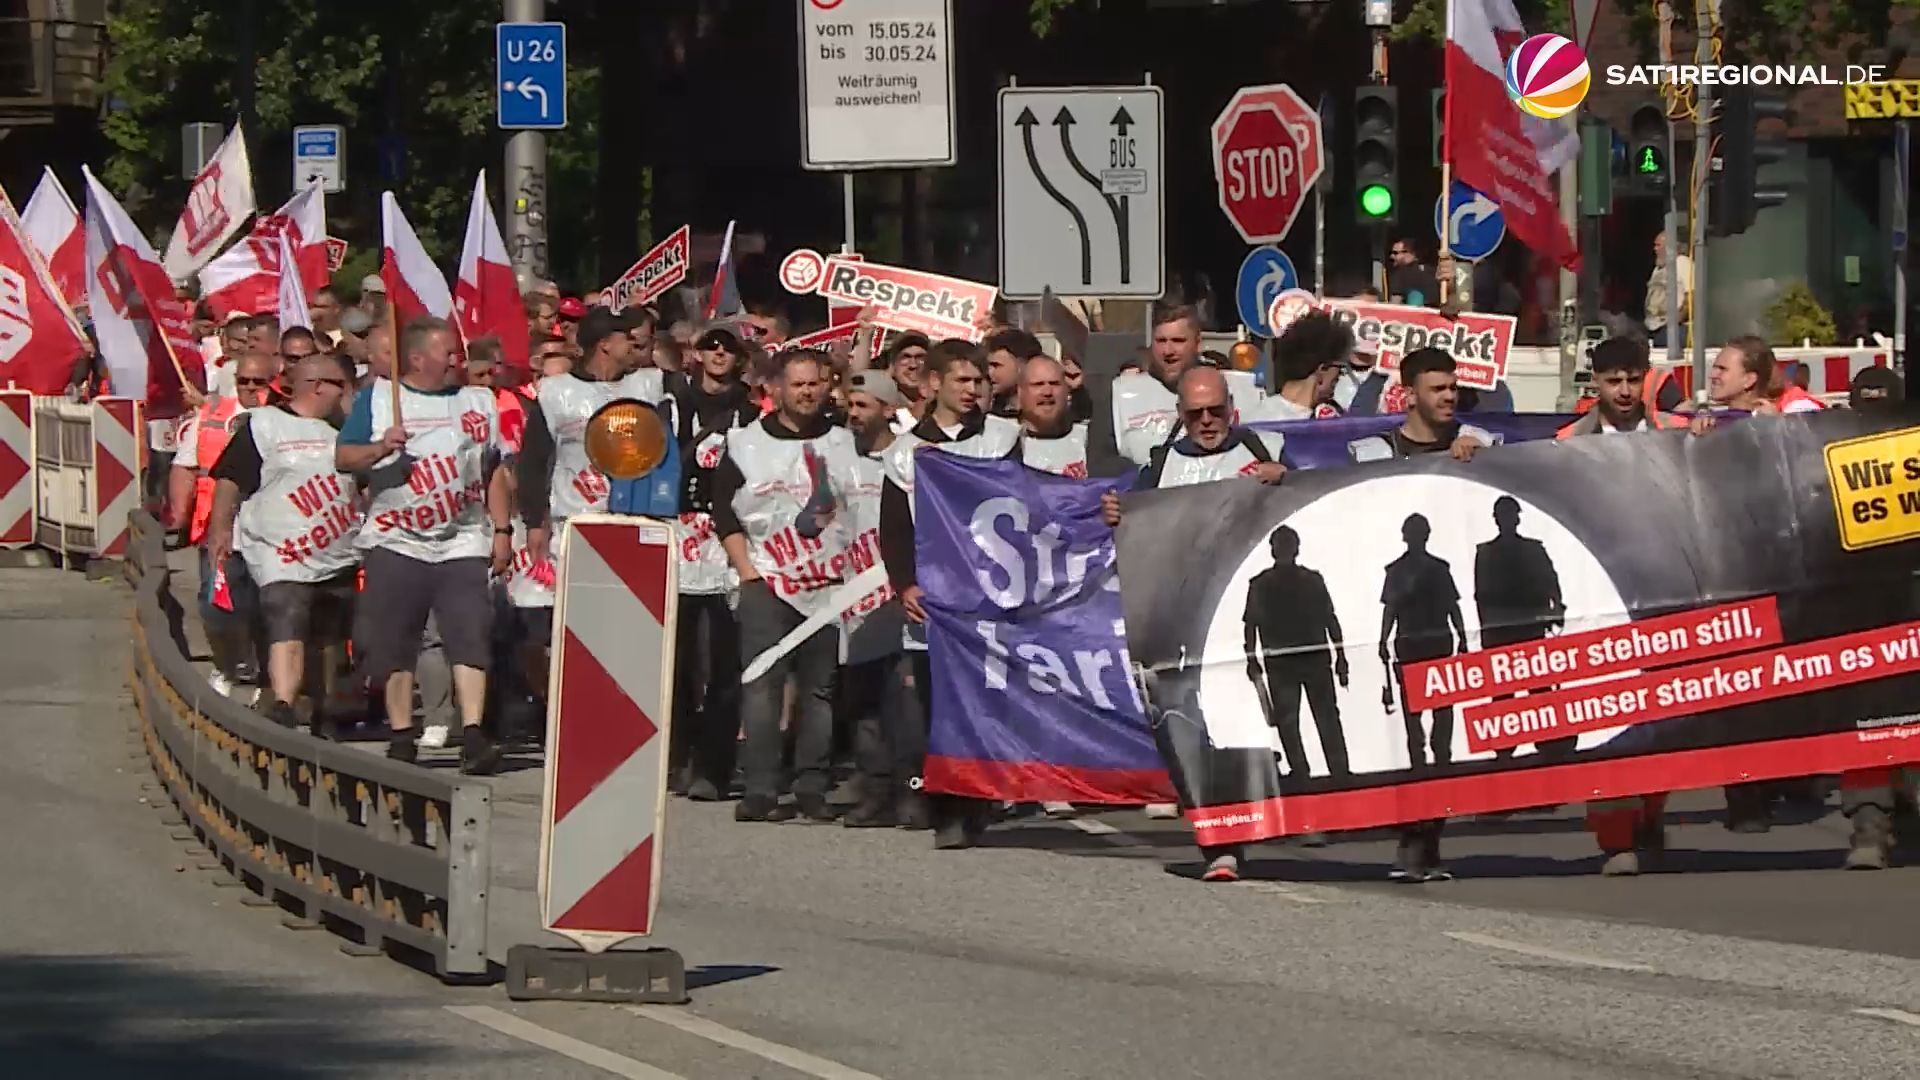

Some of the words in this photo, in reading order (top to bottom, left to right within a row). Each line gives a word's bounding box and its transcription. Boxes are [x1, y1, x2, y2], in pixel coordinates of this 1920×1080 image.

[816, 23, 854, 37] vom
[868, 21, 937, 40] 15.05.24
[507, 40, 523, 62] U
[528, 40, 556, 62] 26
[820, 43, 846, 60] bis
[864, 44, 937, 62] 30.05.24
[835, 91, 921, 106] ausweichen!
[837, 74, 918, 89] Weiträumig
[1110, 138, 1136, 168] BUS
[1227, 146, 1294, 202] STOP
[831, 266, 975, 323] Respekt
[408, 452, 459, 497] Wir
[1840, 458, 1895, 491] Wir
[1903, 452, 1920, 480] s
[288, 473, 341, 517] Wir
[1852, 497, 1888, 524] es
[1425, 660, 1485, 698] Alle
[1491, 645, 1580, 684] Räder
[1588, 627, 1688, 667] stehen
[1696, 607, 1763, 646] still,
[1472, 706, 1558, 741] wenn
[1565, 688, 1649, 724] unser
[1656, 664, 1763, 707] starker
[1773, 653, 1833, 686] Arm
[1840, 645, 1875, 672] es
